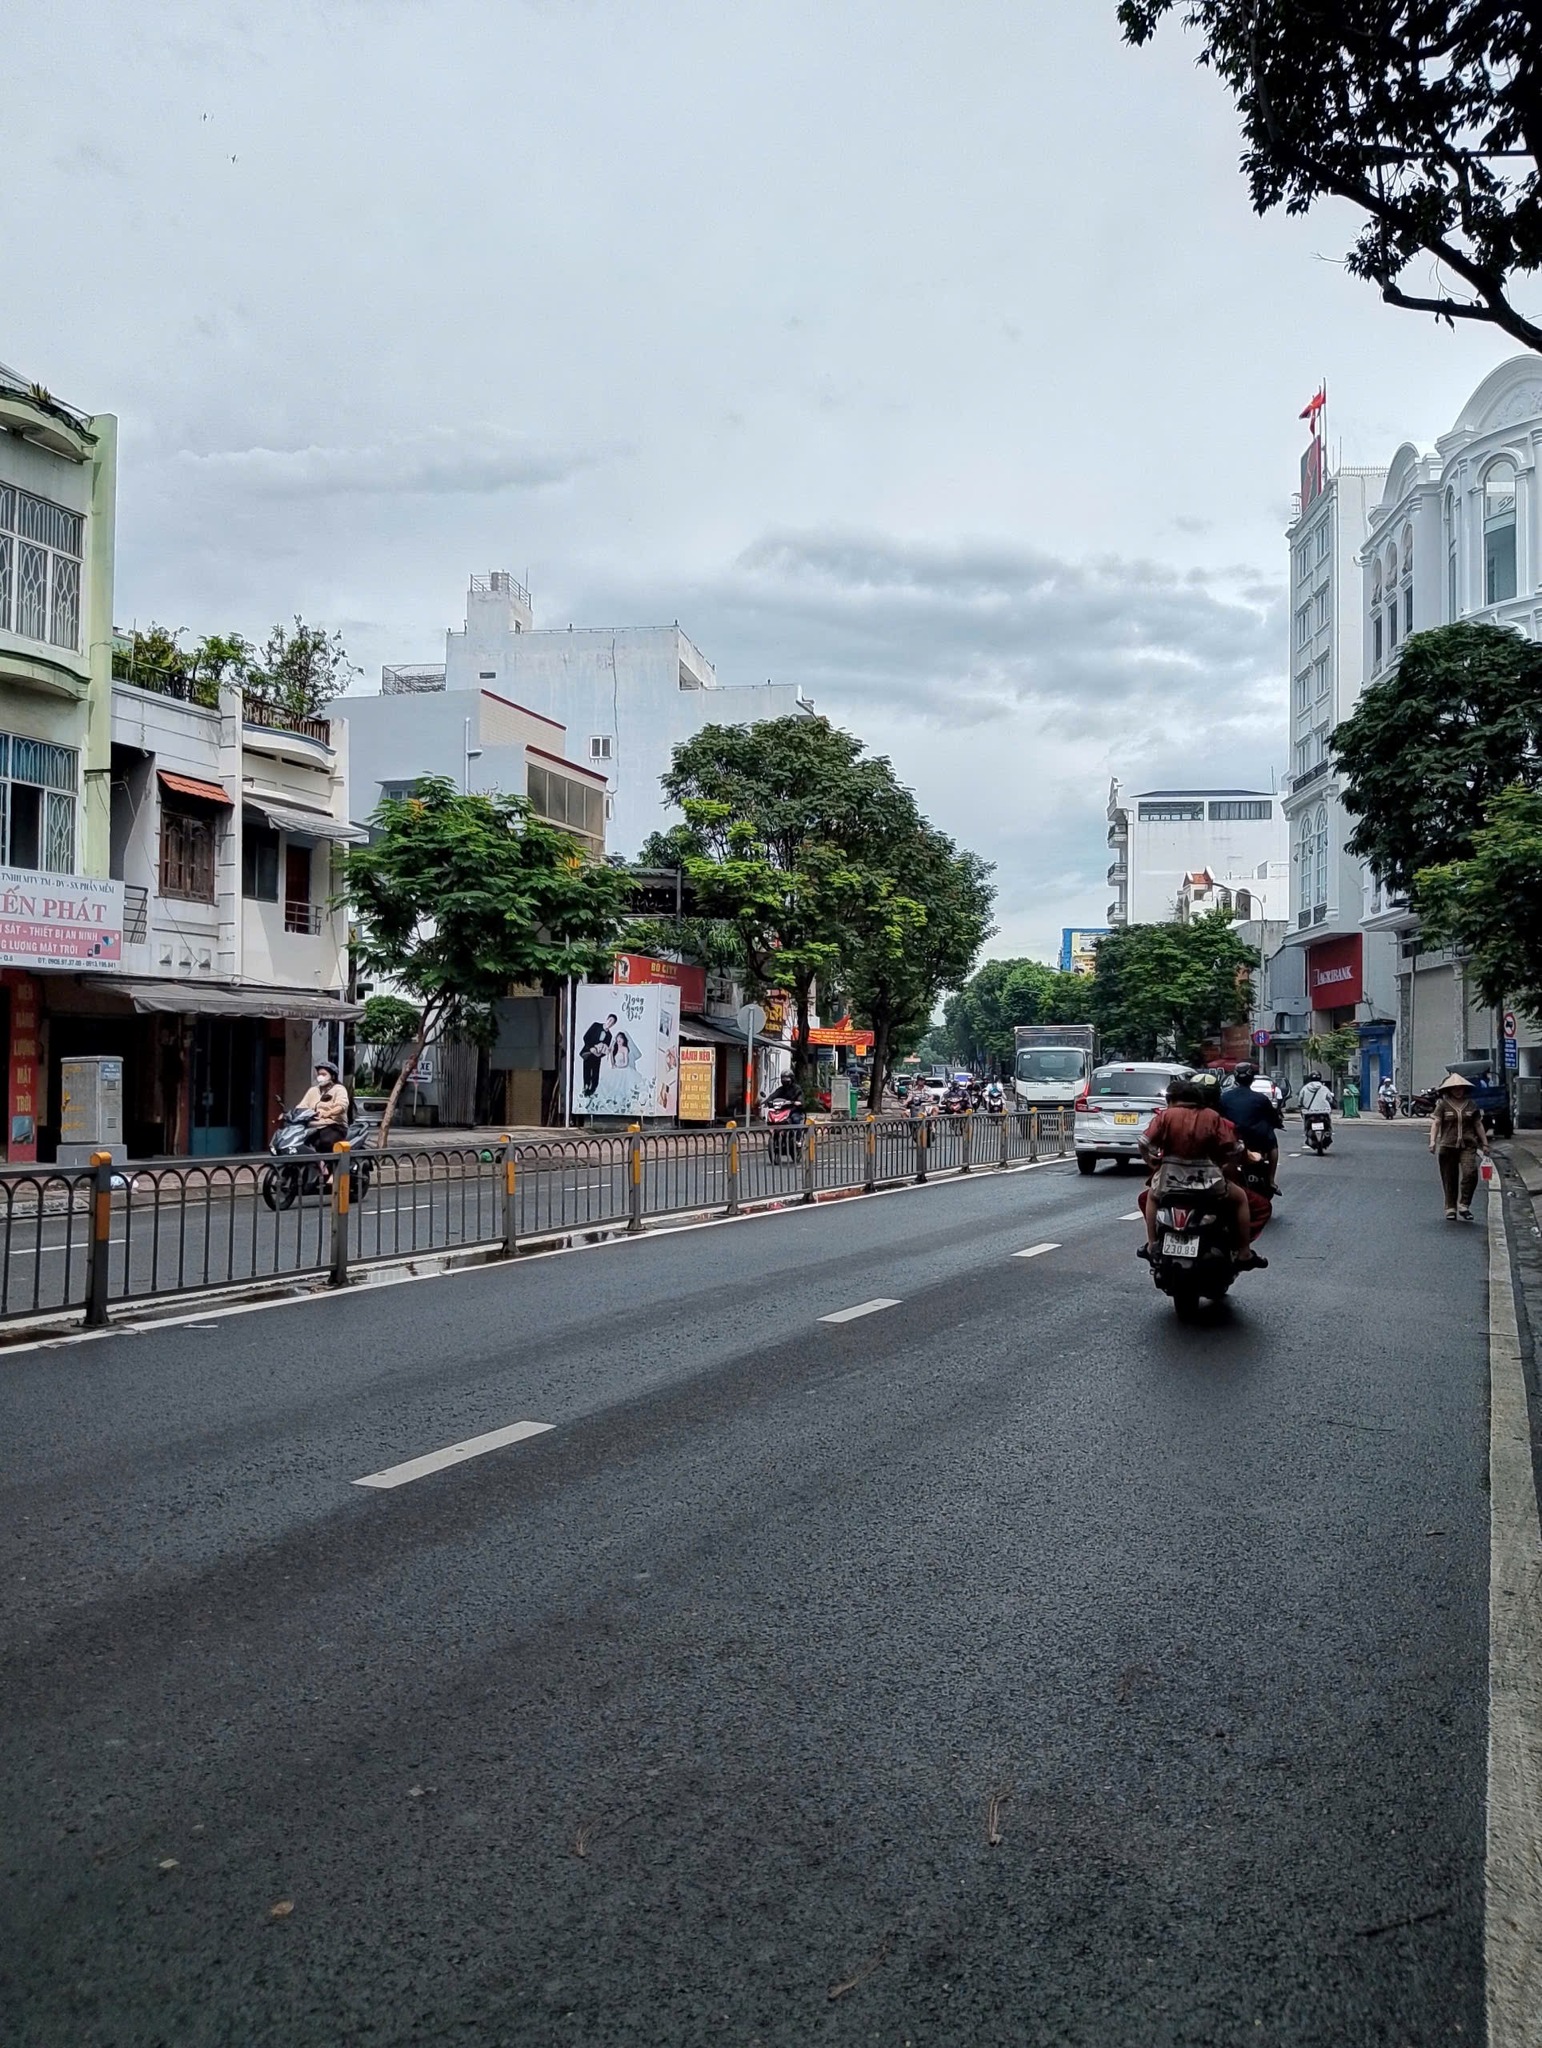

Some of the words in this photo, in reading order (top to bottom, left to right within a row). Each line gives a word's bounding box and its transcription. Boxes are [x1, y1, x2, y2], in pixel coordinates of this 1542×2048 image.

[0, 885, 36, 917] ẾN
[42, 897, 107, 922] PHÁT
[1164, 1245, 1196, 1256] 230.89
